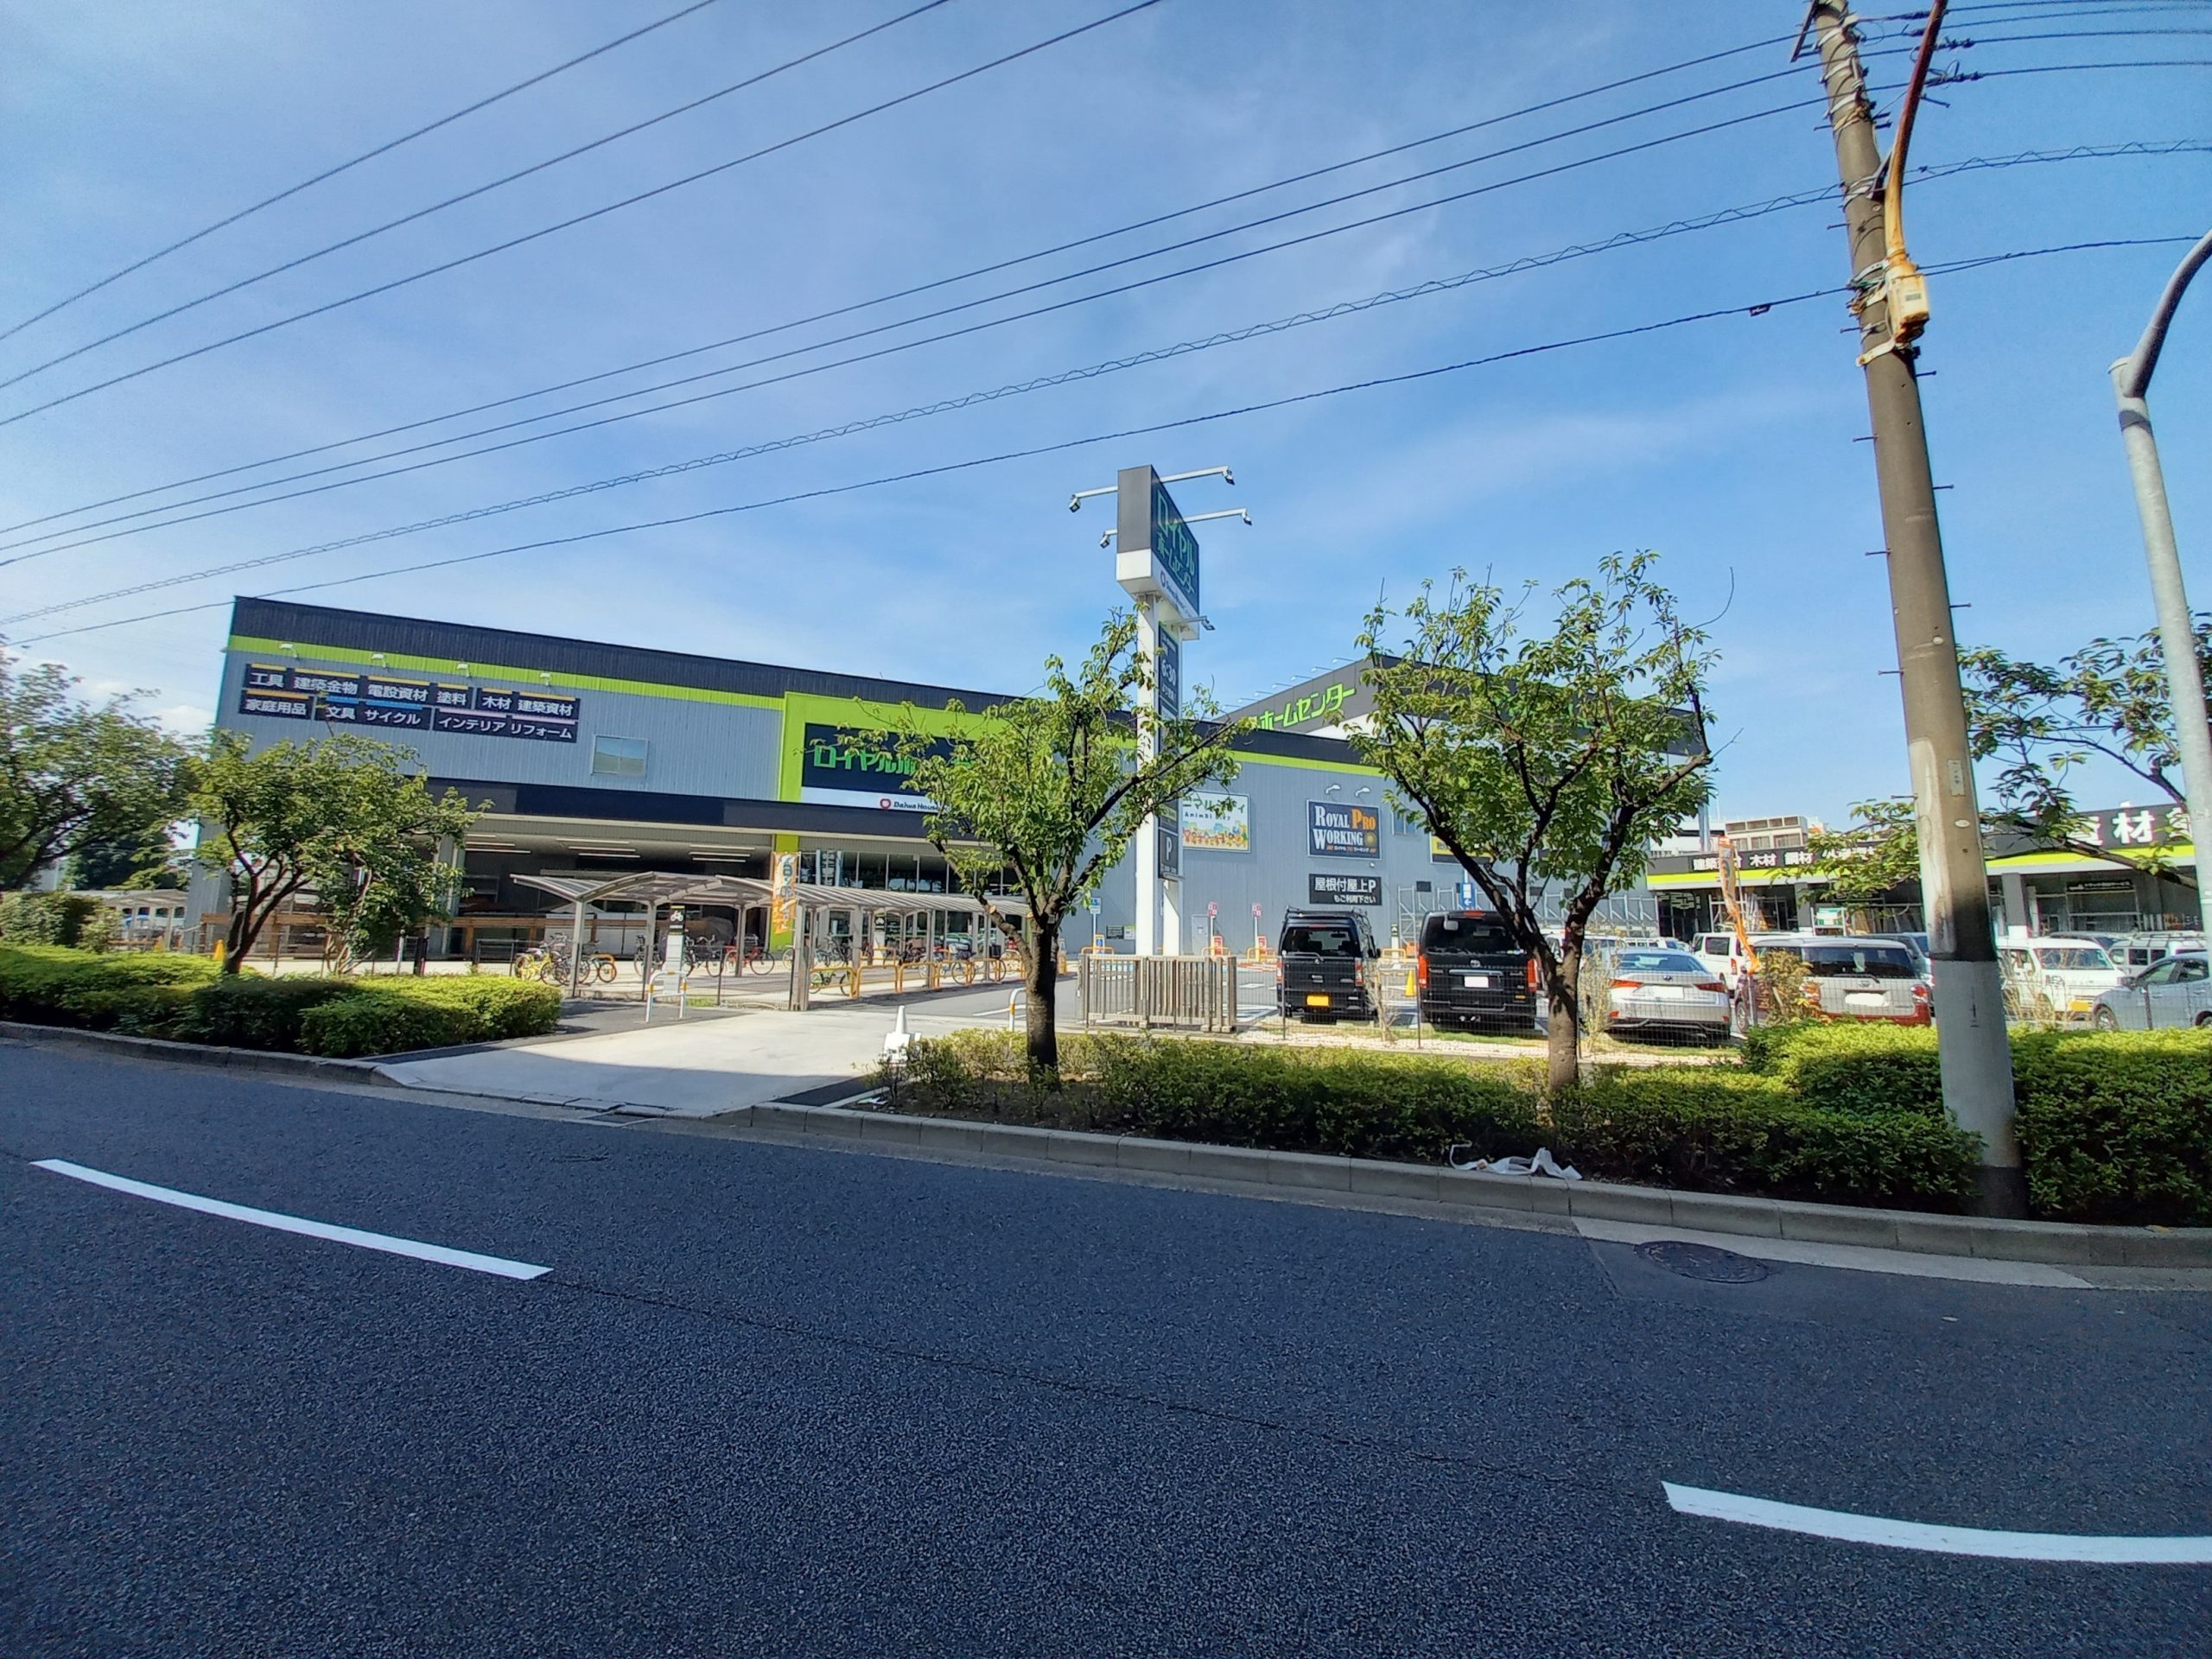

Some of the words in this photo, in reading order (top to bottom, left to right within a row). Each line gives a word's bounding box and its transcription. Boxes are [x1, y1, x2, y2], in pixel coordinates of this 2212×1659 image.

[1161, 659, 1176, 686] 6:30
[249, 672, 283, 688] 工具
[295, 677, 358, 695] 建築金物
[368, 683, 429, 702] 電設資材
[436, 690, 467, 706] 塗料
[482, 696, 512, 710] 木材
[518, 699, 574, 716] 建築資材
[245, 698, 308, 715] 家庭用品
[326, 706, 356, 720] 文具
[365, 709, 421, 725] サイクル
[439, 717, 505, 732] インテリア
[511, 722, 573, 739] リフォーム
[1314, 805, 1350, 829] ROYAL
[1351, 808, 1376, 830] PRO
[1313, 828, 1363, 849] WORKING
[1750, 853, 1777, 867] 木材
[1314, 876, 1376, 893] 屋根付屋上P
